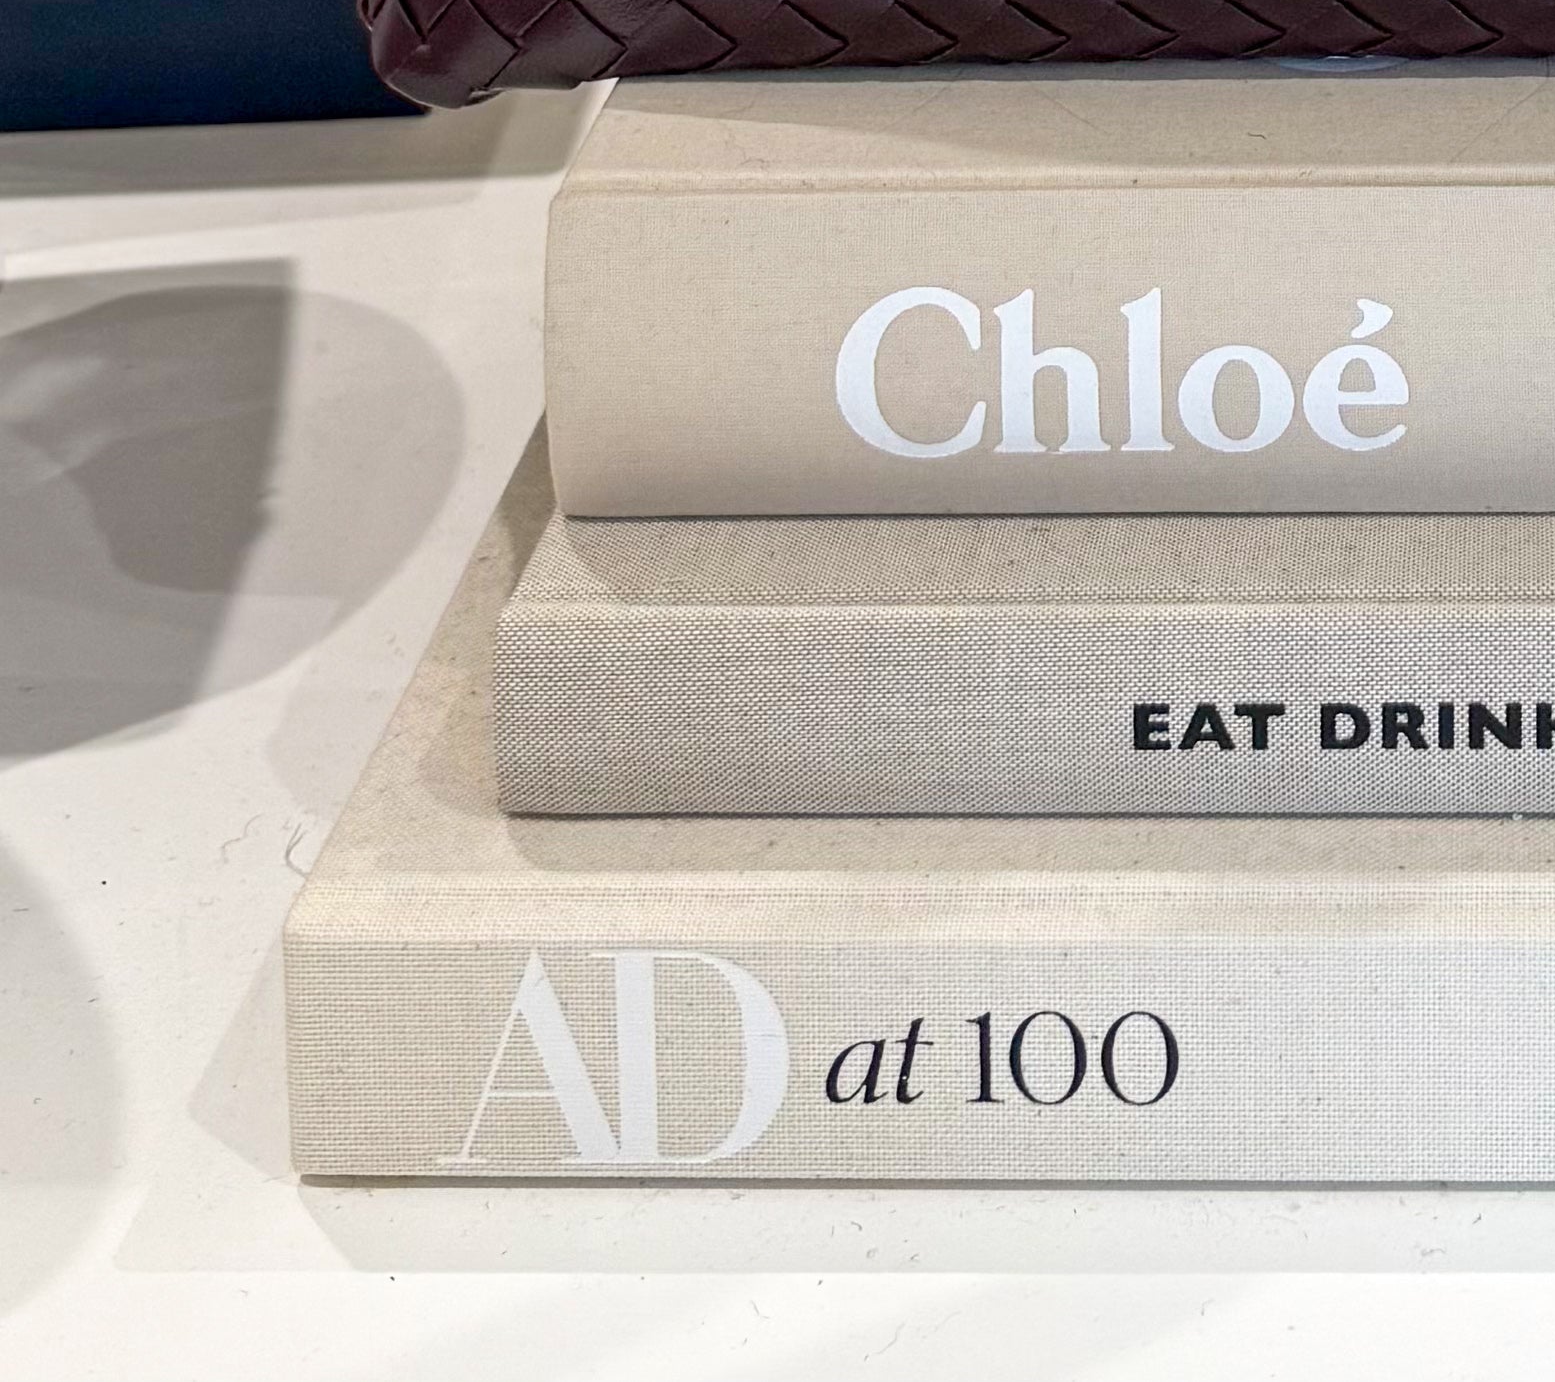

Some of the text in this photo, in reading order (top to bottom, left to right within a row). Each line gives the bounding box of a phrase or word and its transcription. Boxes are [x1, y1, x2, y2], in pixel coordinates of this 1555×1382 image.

[835, 285, 1410, 458] Chloé
[1132, 701, 1286, 751] EAT
[436, 946, 1181, 1166] AD at 100
